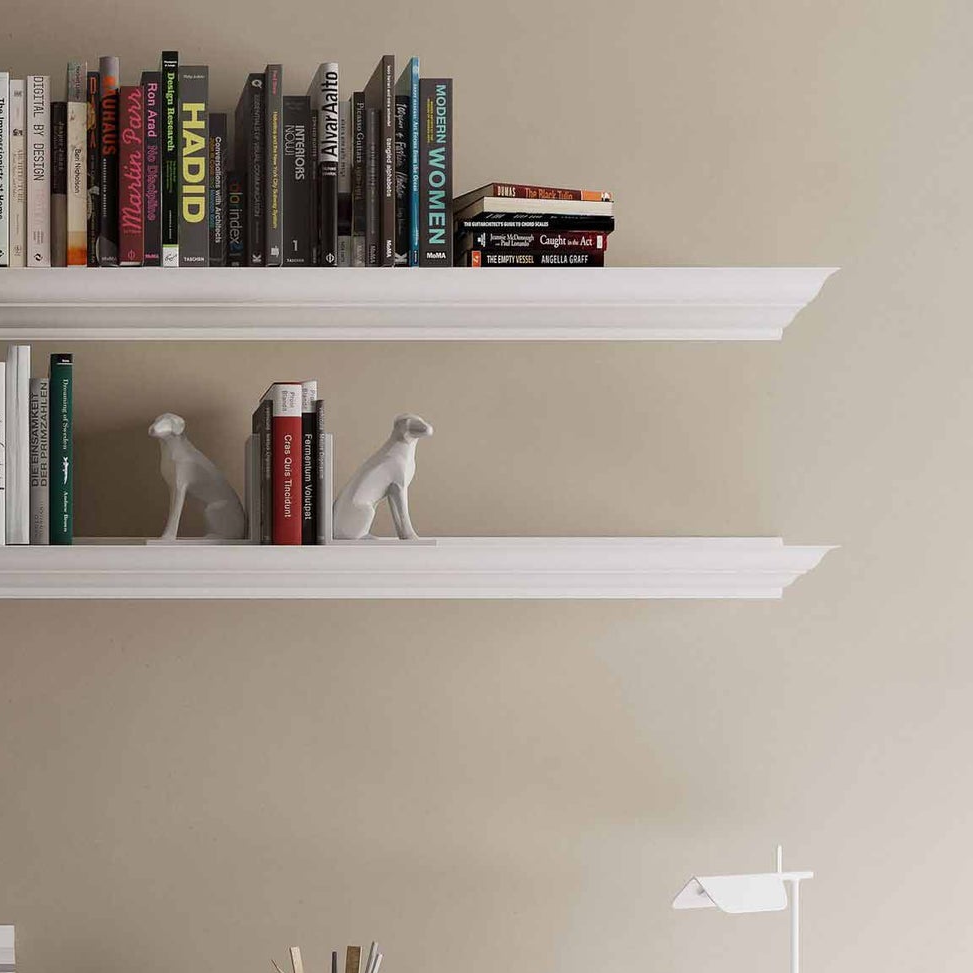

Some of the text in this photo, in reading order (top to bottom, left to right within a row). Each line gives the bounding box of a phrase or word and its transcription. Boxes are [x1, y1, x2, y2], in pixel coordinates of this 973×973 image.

[147, 82, 157, 107] Ron
[165, 72, 175, 105] Design
[33, 76, 45, 182] DIGITAL BY DESIGN
[147, 110, 157, 137] Arad
[166, 107, 175, 151] Research
[356, 102, 365, 163] Picasso Guitars
[436, 85, 447, 144] MODERN
[74, 149, 83, 194] Ben Nicholson
[122, 88, 142, 229] Martin Parr
[182, 103, 205, 223] HADID
[295, 125, 305, 180] INTERIORS
[385, 138, 393, 197] tangled alphabets
[214, 136, 222, 244] Conversations with Architects
[429, 147, 446, 245] WOMEN
[497, 186, 516, 197] DUMAS
[525, 188, 538, 198] The
[229, 209, 244, 244] index
[540, 234, 566, 248] Caught
[580, 236, 592, 246] Act
[426, 252, 446, 260] MoMA
[487, 255, 534, 264] THE EMPTY VESSEL
[541, 255, 588, 264] ANGELLA GRAFF
[61, 379, 69, 413] Dreaming
[31, 392, 39, 487] DIE EINSAMKEIT
[284, 434, 292, 518] Cras Quis Tincidunt
[303, 433, 312, 520] Fermentum Volutpat
